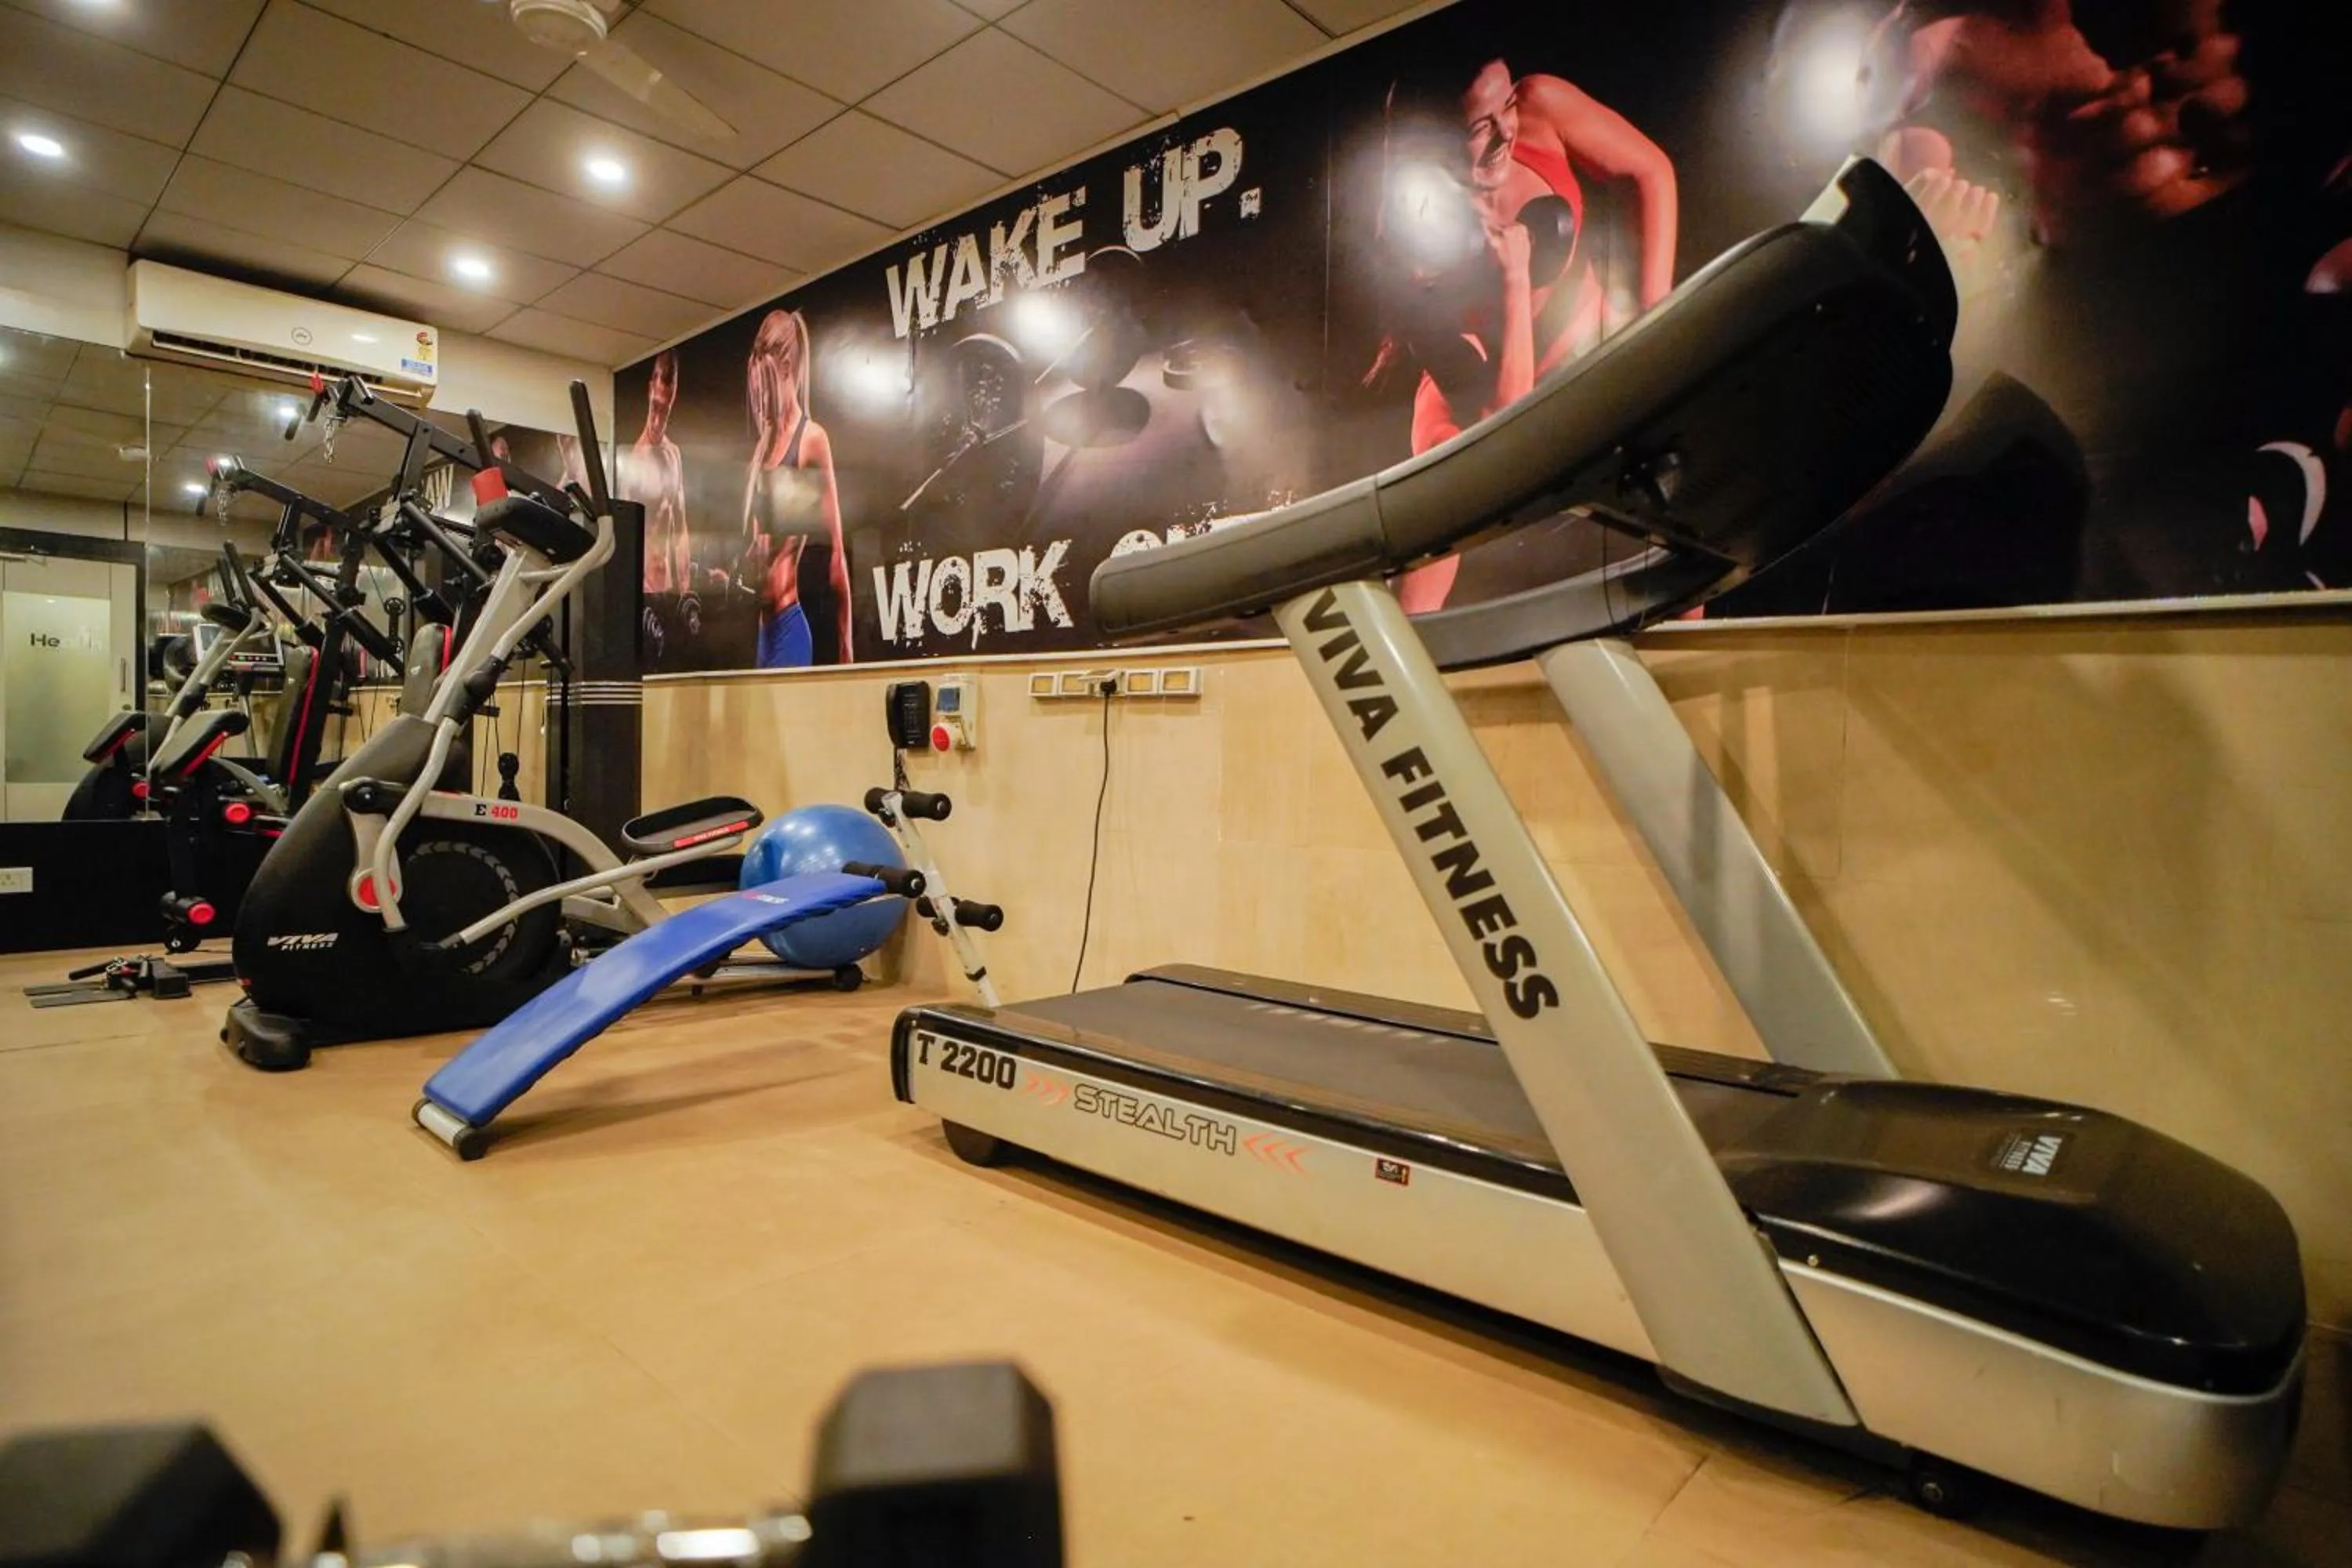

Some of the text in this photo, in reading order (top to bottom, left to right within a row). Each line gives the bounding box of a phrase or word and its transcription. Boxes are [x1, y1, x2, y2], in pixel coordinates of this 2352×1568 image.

[885, 127, 1261, 339] WAKE UP.
[872, 539, 1074, 649] WORK
[474, 804, 518, 819] E 400
[1302, 586, 1559, 1019] VIVA FITNESS
[267, 932, 339, 947] VIVA
[281, 942, 334, 952] FITNESS
[916, 1033, 1017, 1091] T 2200
[1073, 1082, 1237, 1156] STEALTH
[2021, 1135, 2063, 1176] VIVA
